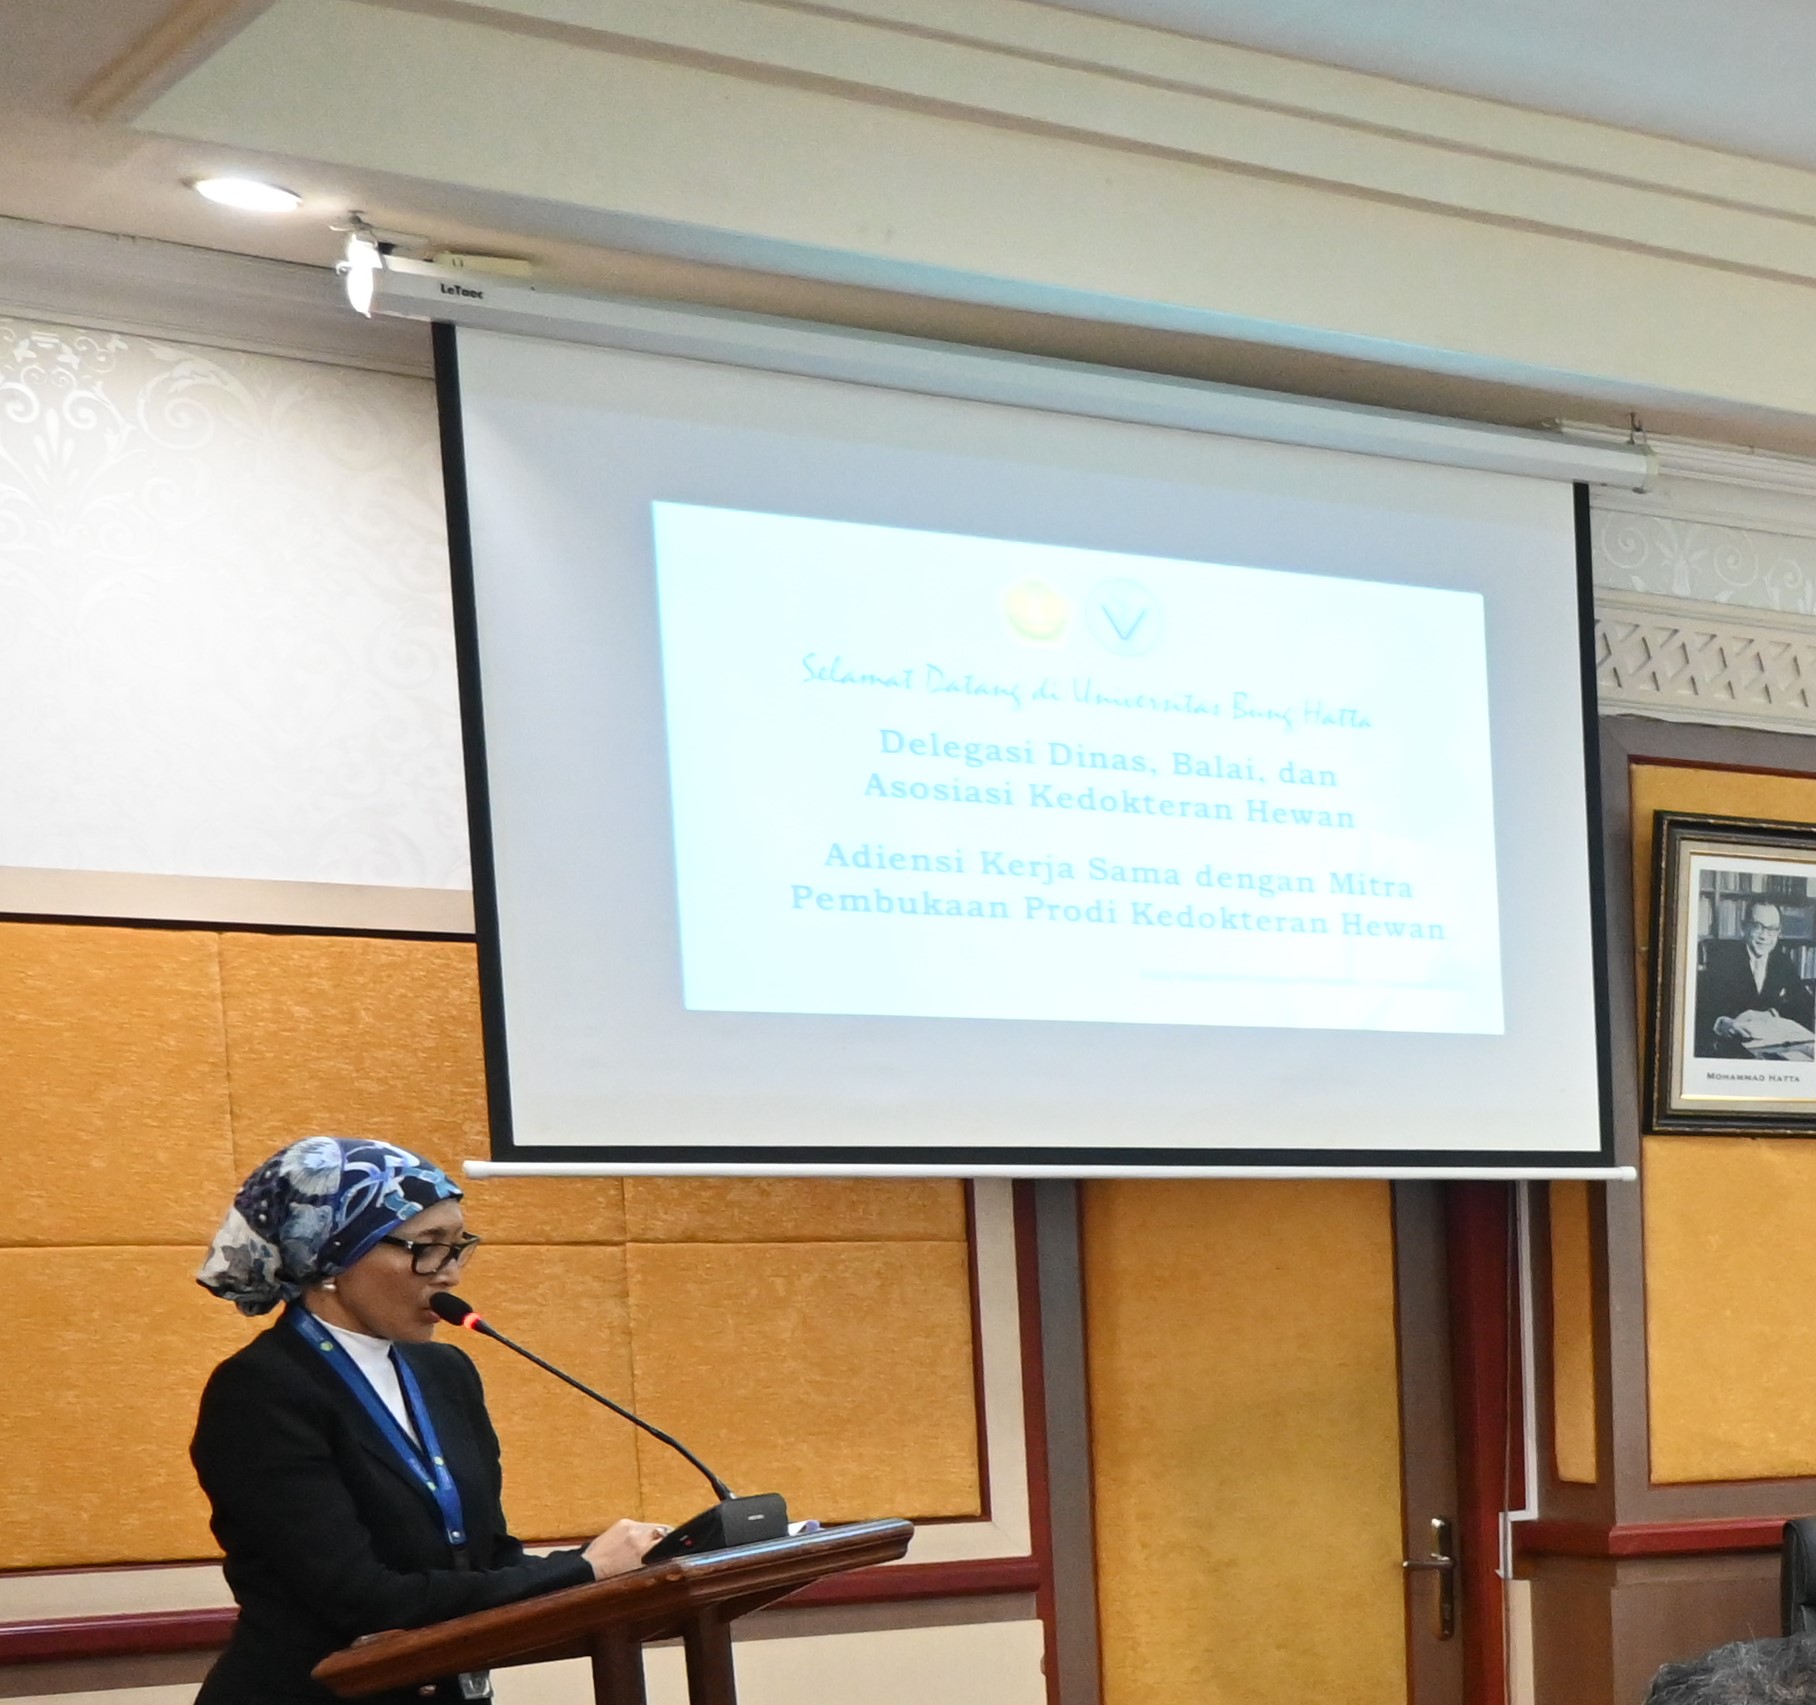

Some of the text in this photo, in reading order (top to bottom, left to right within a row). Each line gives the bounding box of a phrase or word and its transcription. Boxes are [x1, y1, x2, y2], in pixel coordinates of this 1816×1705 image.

[801, 652, 1375, 734] Selamat Datang di Universitas Bung Hatta
[879, 728, 1339, 788] Delegasi Dinas, Balai, dan
[864, 772, 1358, 829] Asosiasi Kedokteran Hewan
[824, 842, 1414, 899] Adiensi Kerja Sama dengan Mitra
[790, 884, 1448, 941] Pembukaan Prodi Kedokteran Hewan
